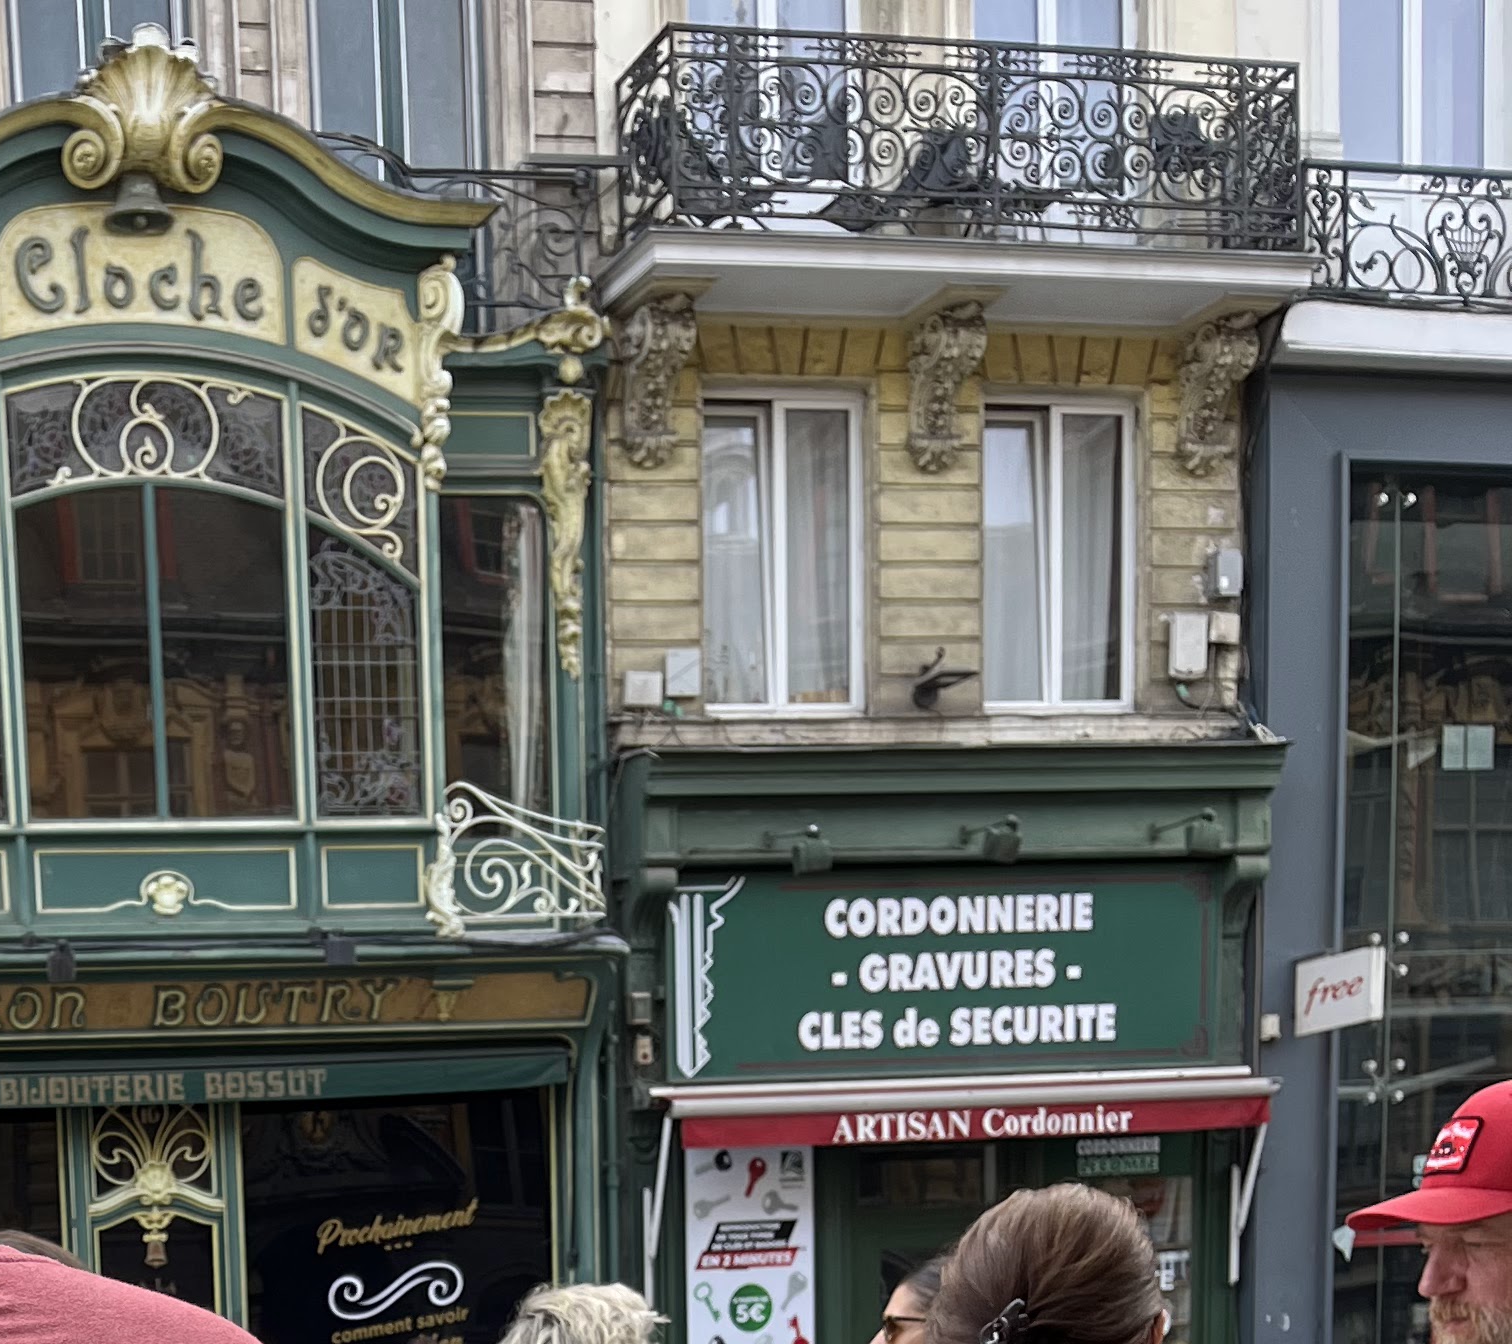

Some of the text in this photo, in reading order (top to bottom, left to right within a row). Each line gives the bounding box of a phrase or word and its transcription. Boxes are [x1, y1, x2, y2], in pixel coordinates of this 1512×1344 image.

[15, 225, 264, 321] Cloche
[824, 892, 1094, 939] CORDONNERIE
[858, 948, 1057, 993] GRAVURES
[153, 980, 396, 1027] BOUTRY
[1304, 976, 1364, 1016] free
[797, 1002, 1117, 1051] CLES de SECURITE
[0, 1072, 186, 1106] BIJOUTERIE
[832, 1105, 1133, 1145] ARTISAN Cordonnier
[316, 1197, 479, 1254] Prochainement
[331, 1307, 469, 1344] comment savoir
